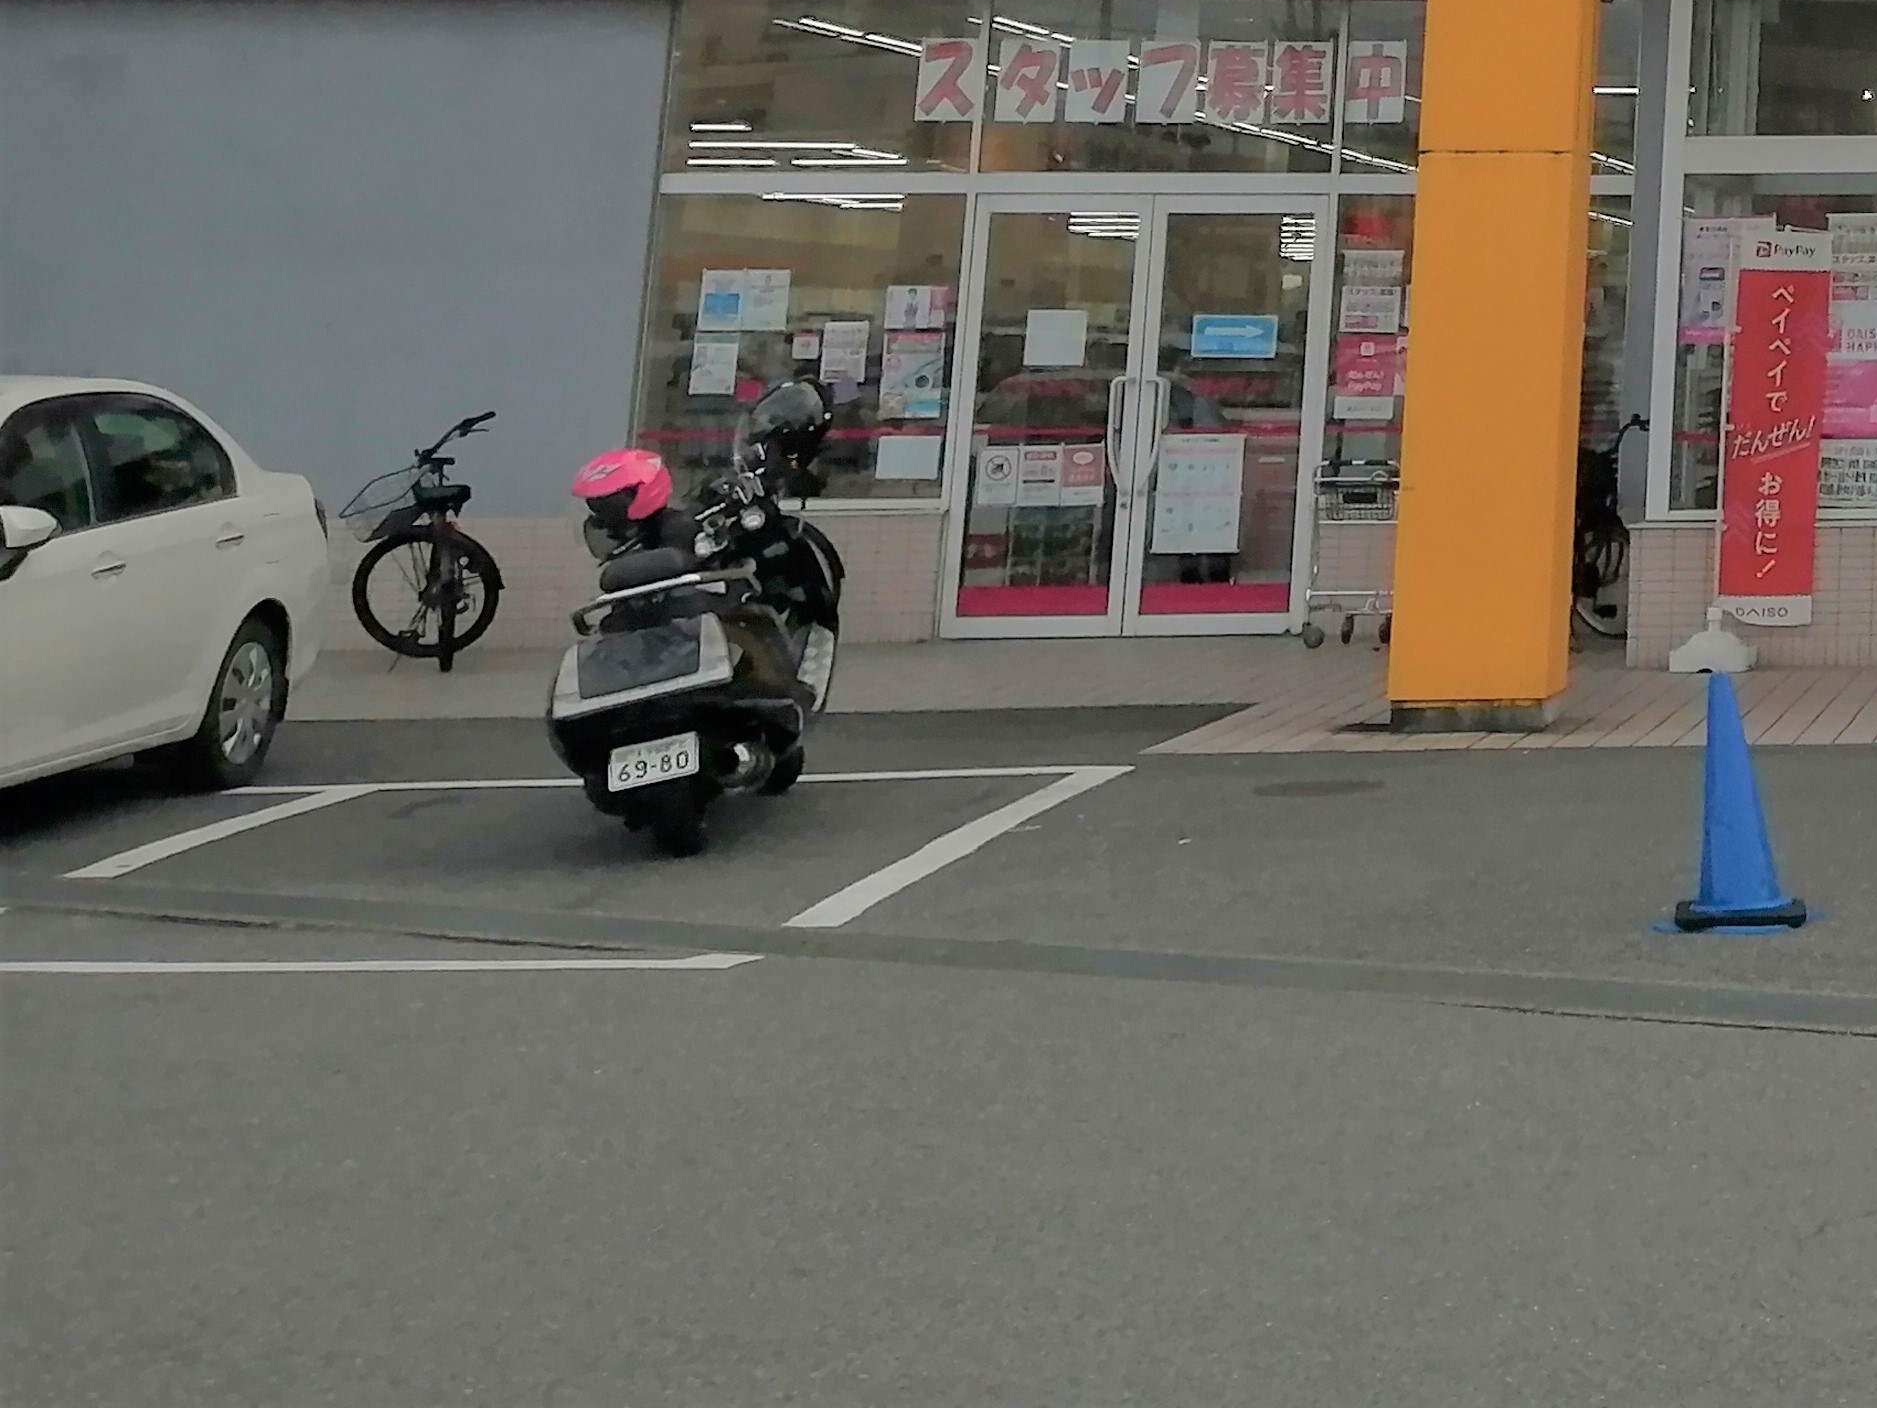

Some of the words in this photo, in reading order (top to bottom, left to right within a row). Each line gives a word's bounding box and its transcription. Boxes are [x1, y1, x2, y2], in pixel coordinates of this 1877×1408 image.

[915, 41, 1404, 120] スタッフ募集中
[1774, 244, 1816, 257] PayPay
[1765, 285, 1795, 412] ペイペイで
[1735, 606, 1789, 618] DAISO
[619, 750, 689, 782] 69-80
